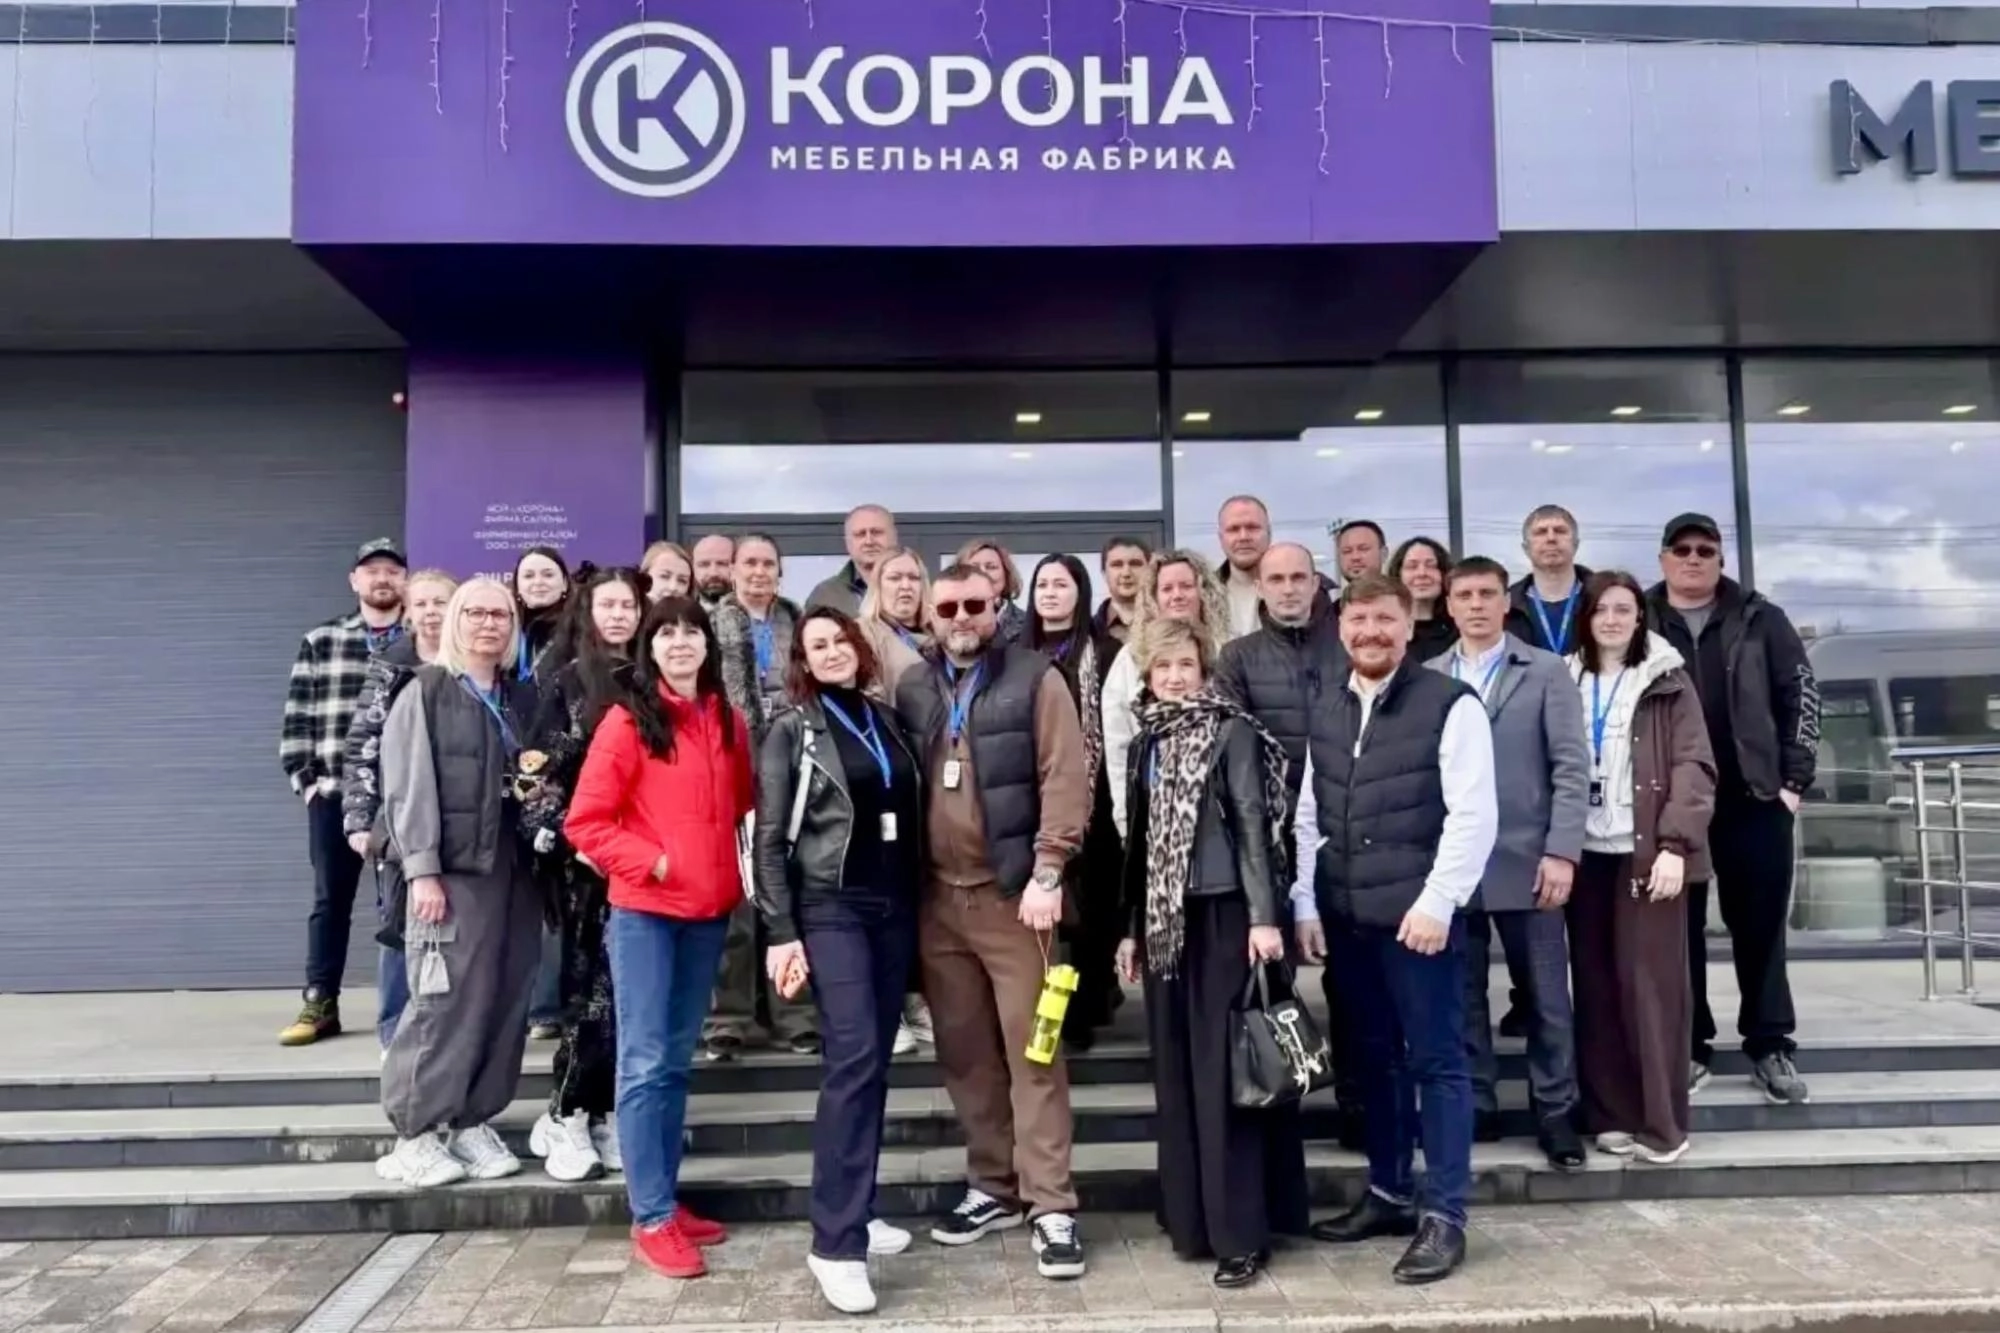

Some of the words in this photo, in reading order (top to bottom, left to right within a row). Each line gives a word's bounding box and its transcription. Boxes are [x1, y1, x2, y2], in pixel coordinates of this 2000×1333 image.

[770, 46, 1235, 126] КОРОНА
[770, 146, 1020, 171] МЕБЕЛЬНАЯ
[1041, 147, 1236, 171] ФАБРИКА
